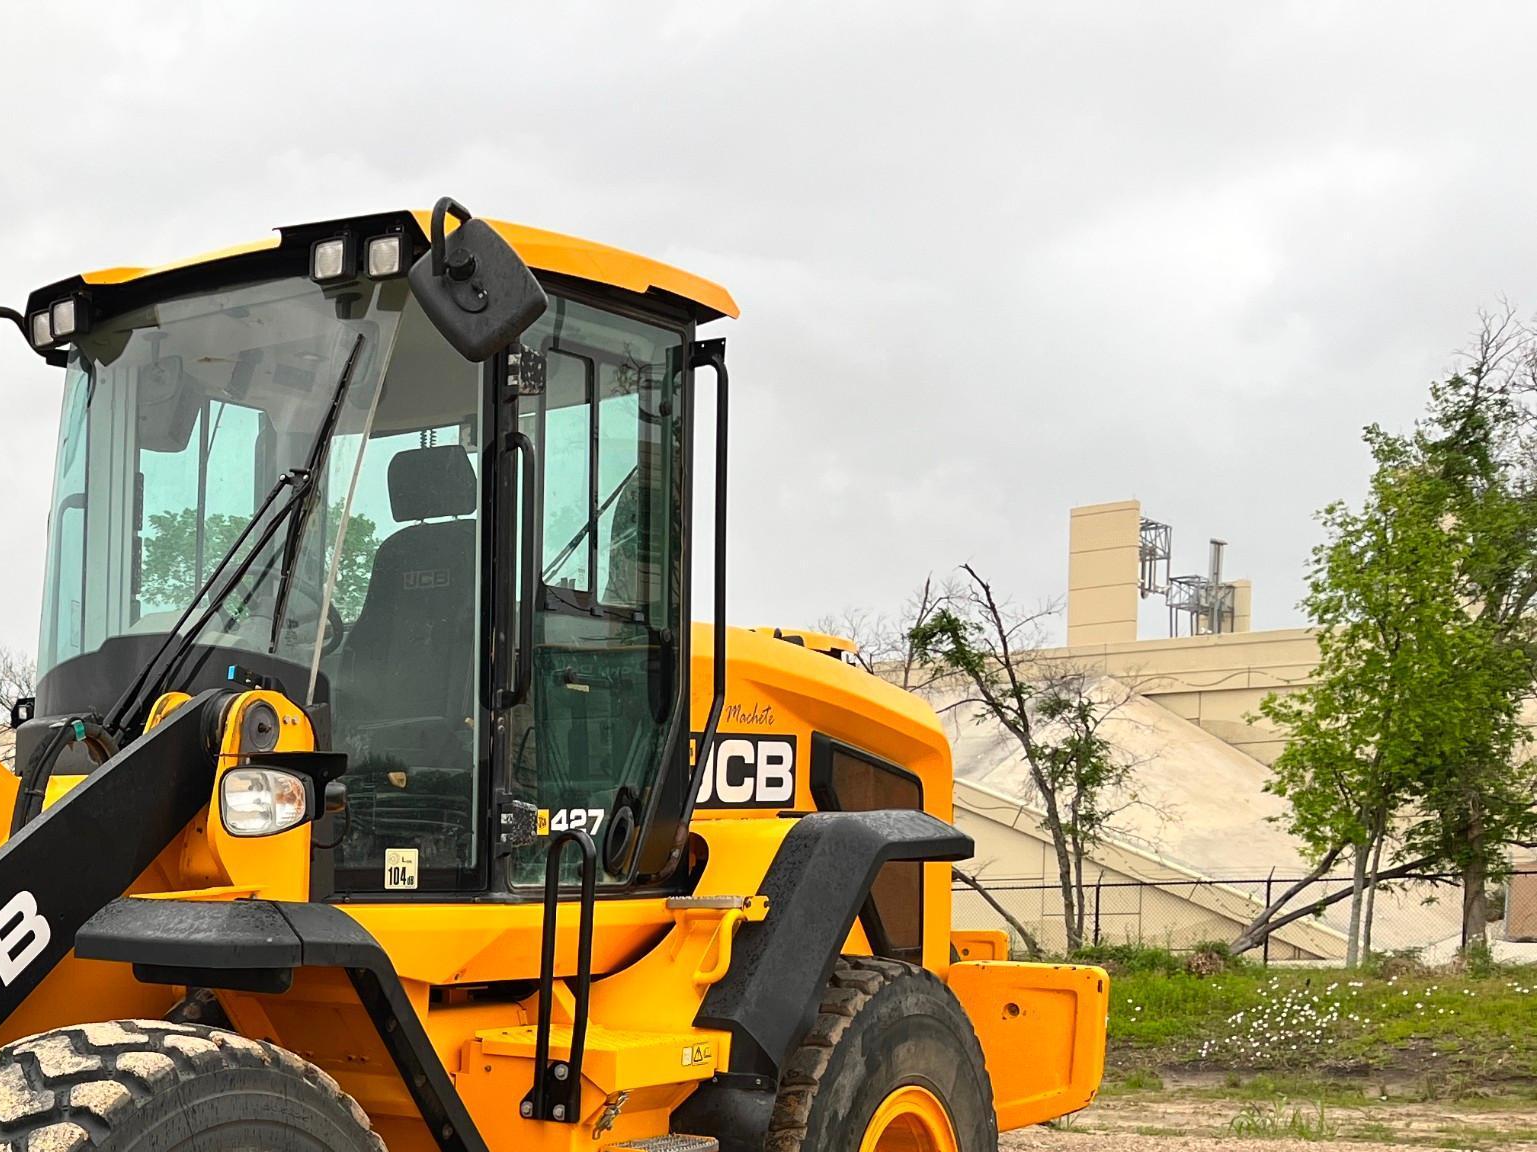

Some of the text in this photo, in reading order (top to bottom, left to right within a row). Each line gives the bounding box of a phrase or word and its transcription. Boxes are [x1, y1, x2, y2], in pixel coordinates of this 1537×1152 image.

[725, 702, 775, 726] Machete
[551, 809, 604, 835] 427
[388, 867, 406, 885] 104
